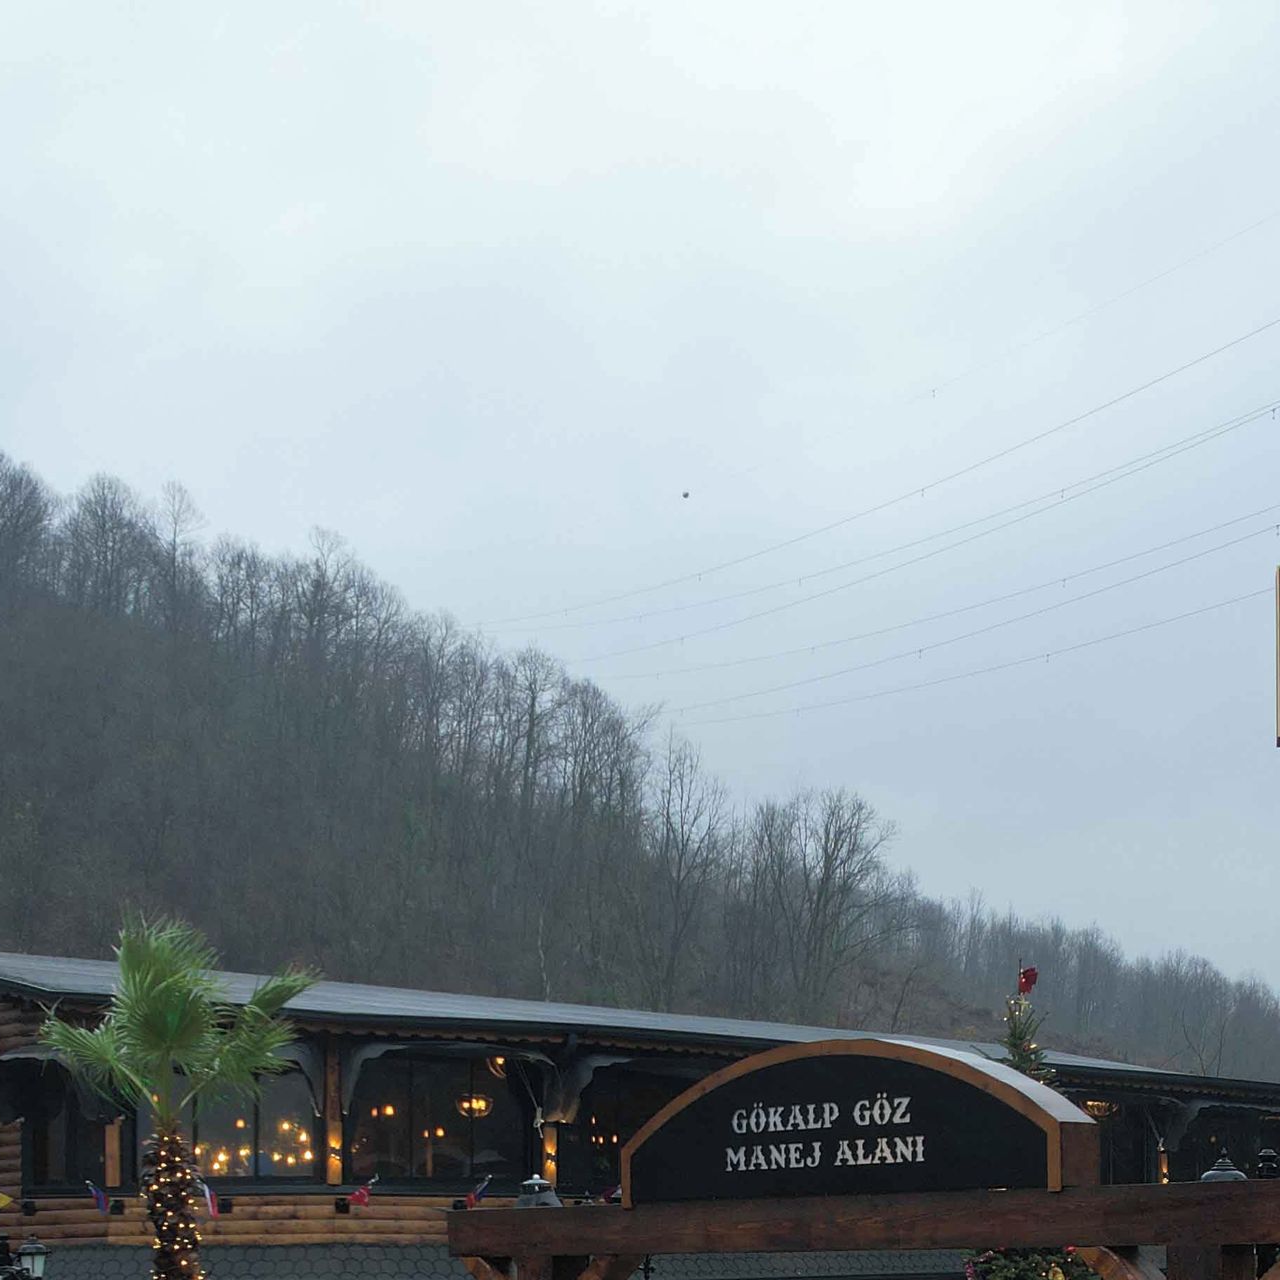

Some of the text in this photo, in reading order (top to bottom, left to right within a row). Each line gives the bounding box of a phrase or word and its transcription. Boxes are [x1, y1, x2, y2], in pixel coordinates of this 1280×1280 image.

[732, 1092, 911, 1134] GÖKALP GÖZ
[725, 1136, 925, 1171] MANEJ ALANI
